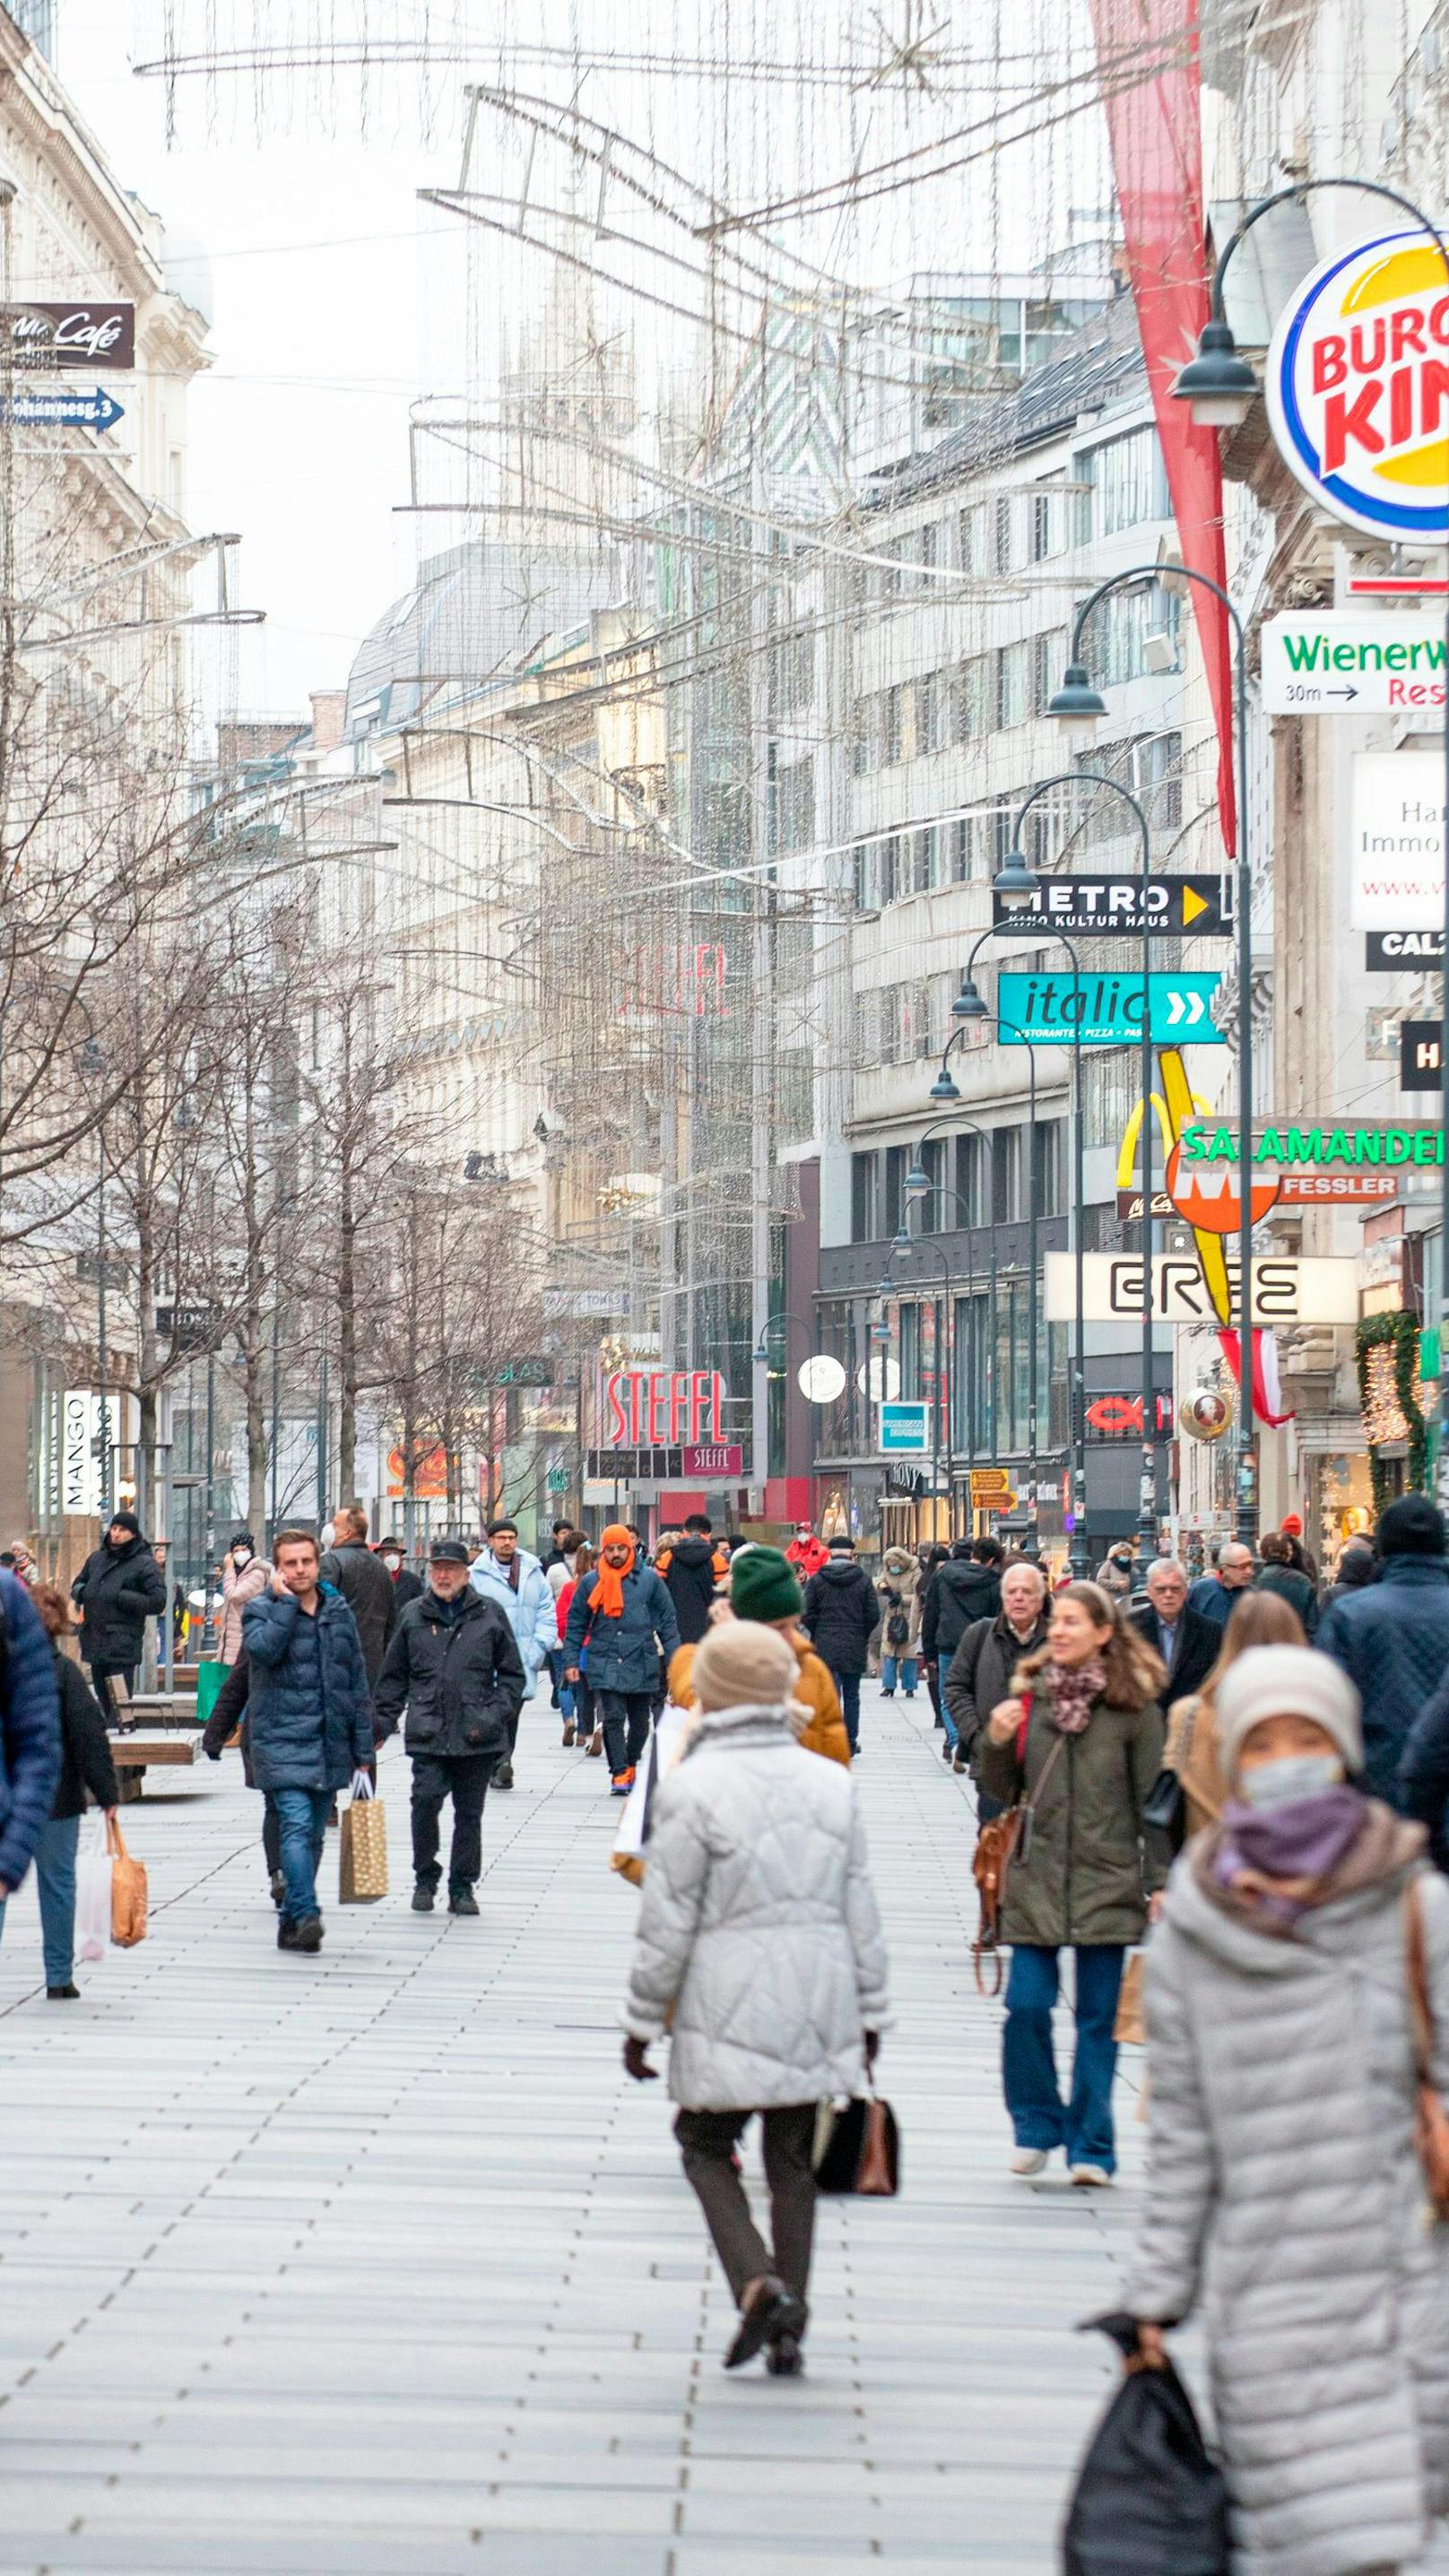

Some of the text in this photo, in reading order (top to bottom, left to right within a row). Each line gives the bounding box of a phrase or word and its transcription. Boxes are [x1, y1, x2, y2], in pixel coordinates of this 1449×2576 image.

[13, 400, 113, 420] ohannesg.3
[1324, 360, 1449, 472] KIN
[1286, 679, 1445, 705] 30m Res
[1362, 831, 1439, 853] Immo
[1054, 915, 1119, 927] KULTUR
[1125, 915, 1169, 927] HAUS
[1014, 1028, 1152, 1038] RSTORANTE PIZZA PAS
[1182, 1124, 1445, 1166] SAAMANDE
[1283, 1176, 1395, 1195] FESSLER
[607, 1370, 728, 1445] STEFFL
[67, 1399, 84, 1505] MANGO
[694, 1448, 730, 1468] STEFFL
